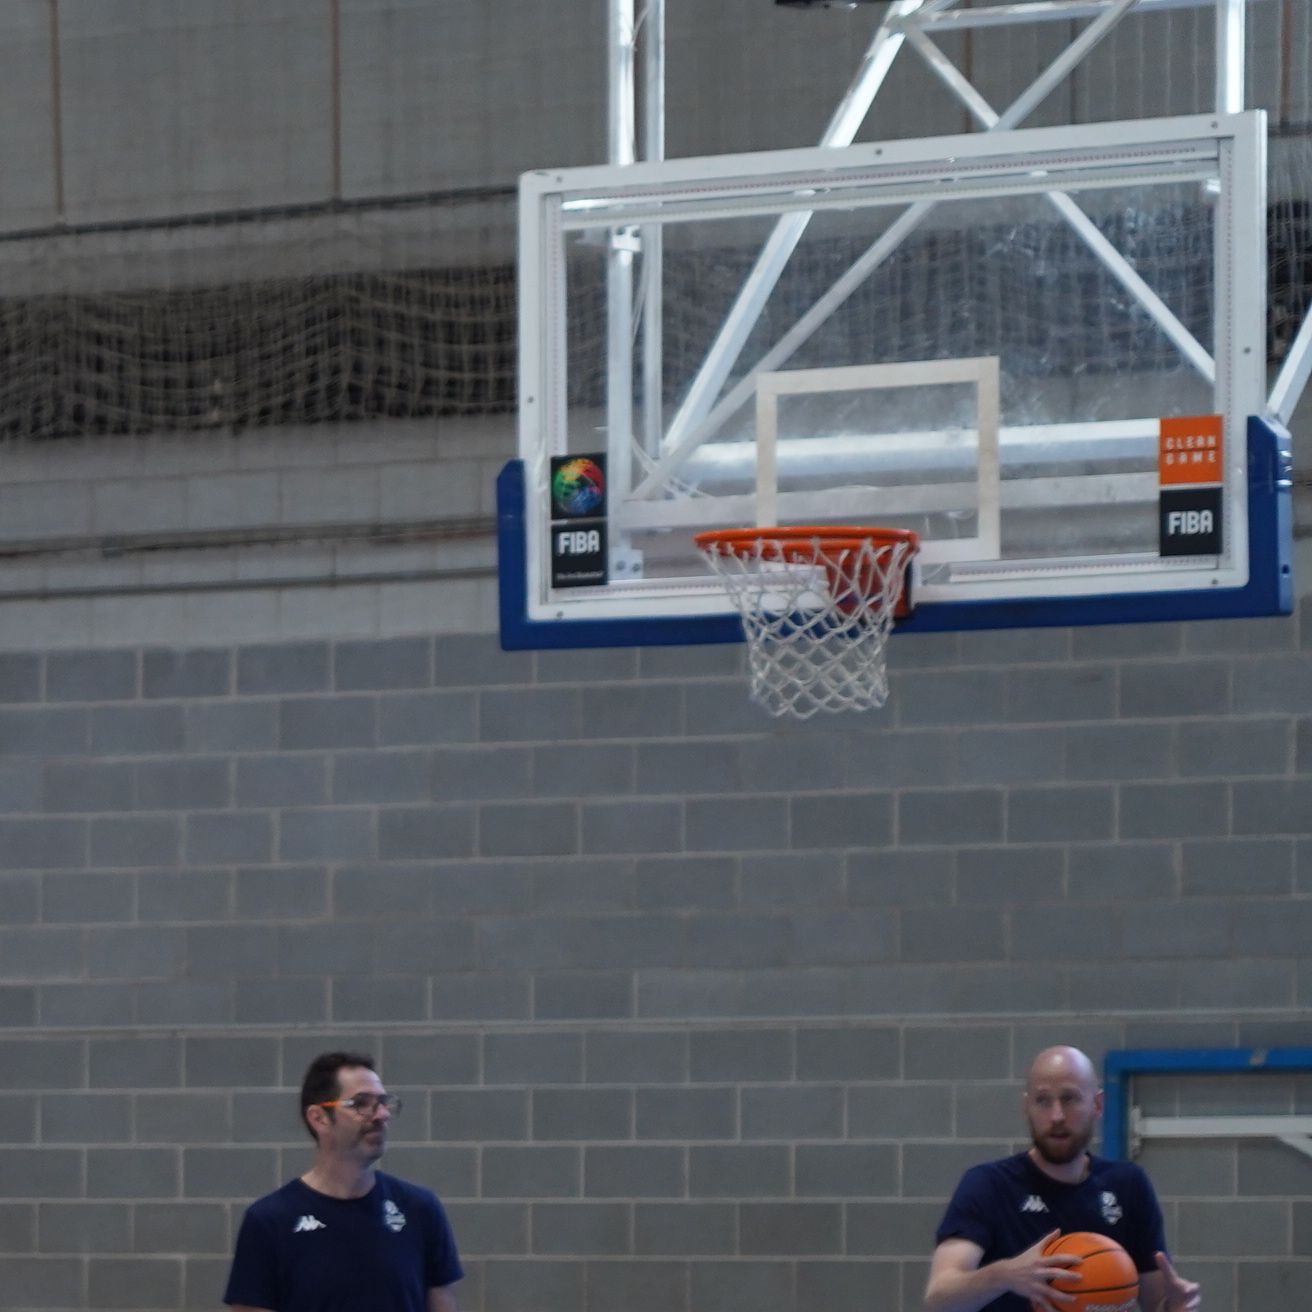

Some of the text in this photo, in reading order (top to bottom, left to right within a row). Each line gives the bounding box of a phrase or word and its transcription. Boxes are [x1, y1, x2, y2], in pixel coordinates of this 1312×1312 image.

[1165, 434, 1217, 450] CLEAN
[1165, 449, 1217, 465] GAME
[1168, 509, 1214, 535] FIBA
[558, 529, 601, 555] FIBA
